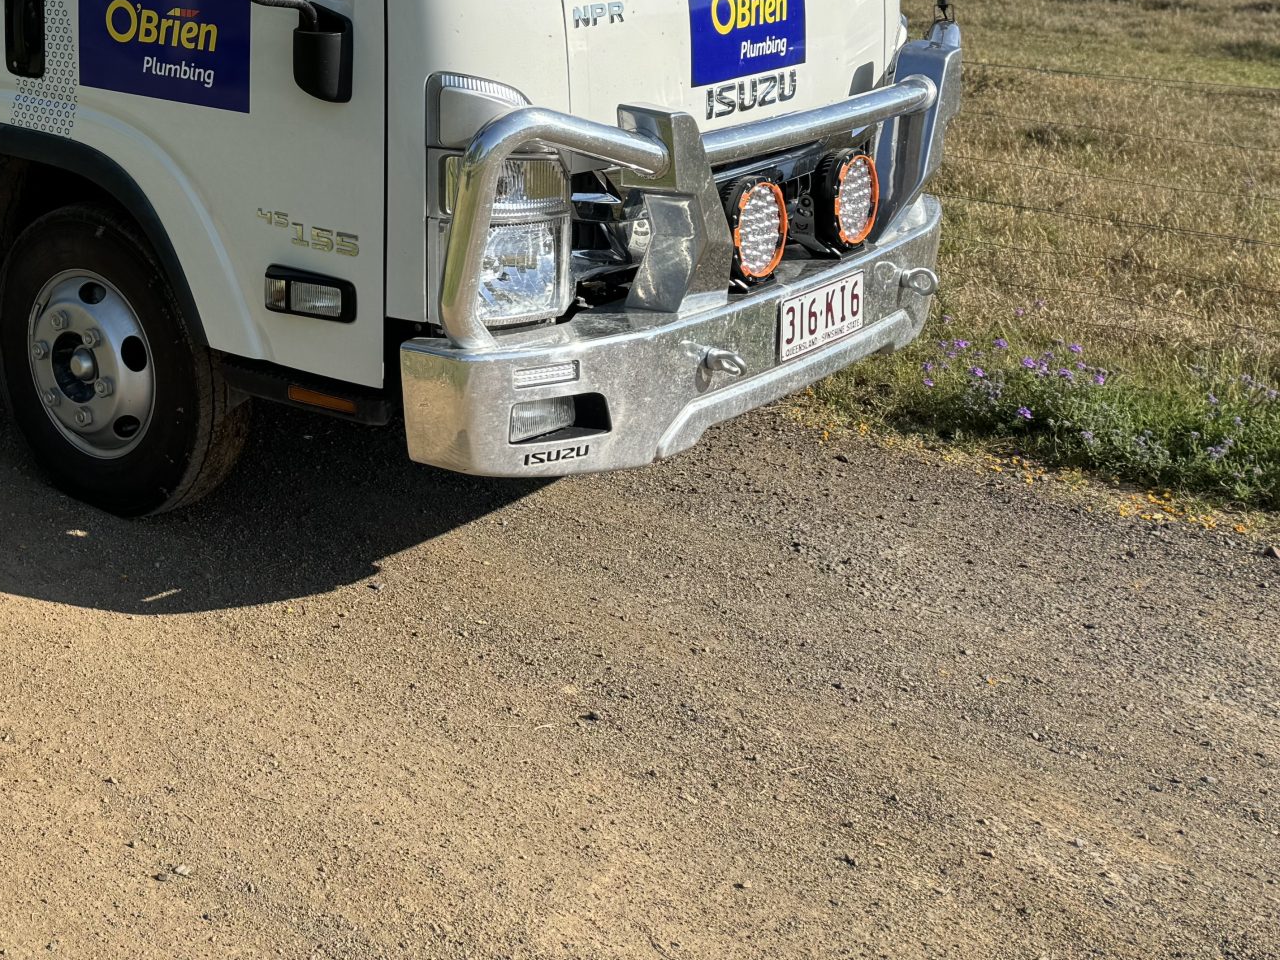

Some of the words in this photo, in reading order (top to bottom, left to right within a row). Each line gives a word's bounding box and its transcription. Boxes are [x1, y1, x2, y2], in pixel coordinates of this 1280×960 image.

[573, 0, 625, 28] NPR
[740, 36, 787, 59] Plumbing
[142, 56, 215, 88] Plumbing
[705, 69, 797, 120] ISUZU
[291, 222, 360, 257] 155
[785, 337, 818, 357] QUEENSLAND
[821, 326, 845, 342] SUNSHINE
[846, 318, 860, 332] STATE
[523, 445, 590, 466] ISUZU
